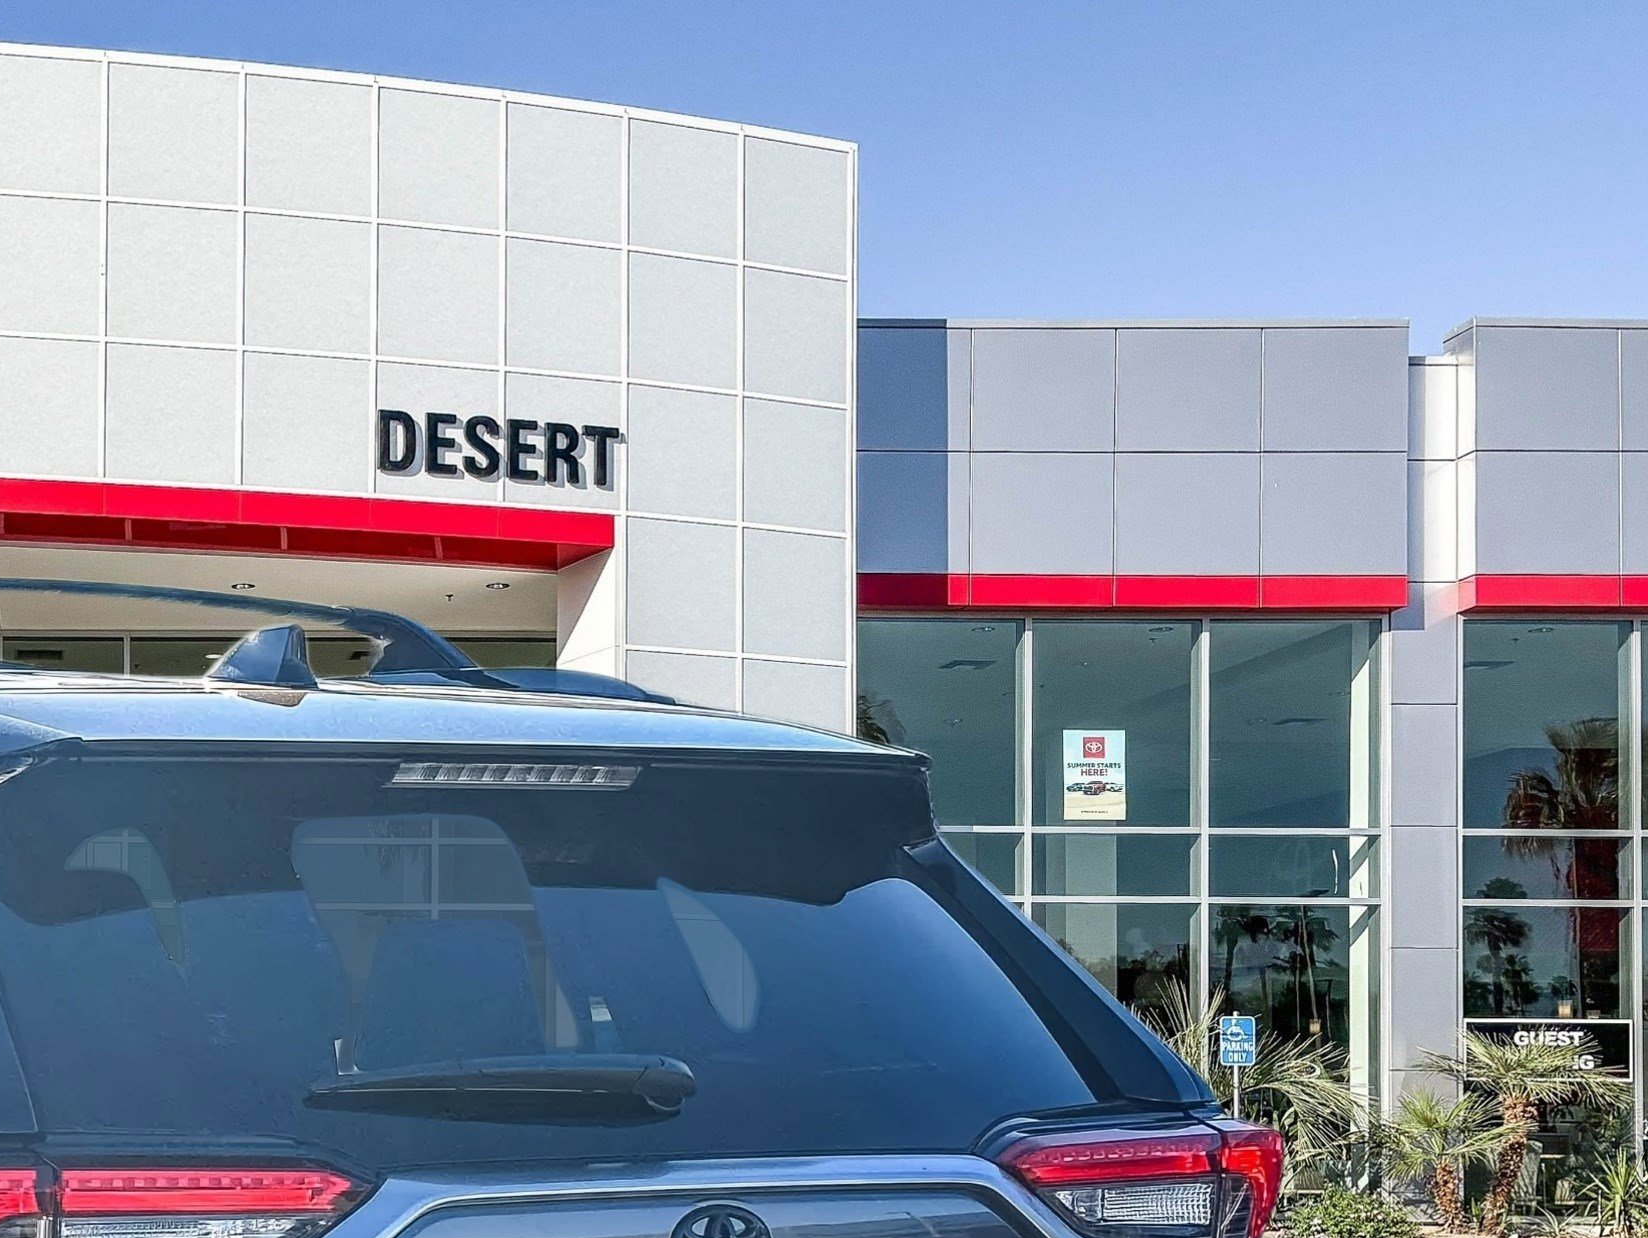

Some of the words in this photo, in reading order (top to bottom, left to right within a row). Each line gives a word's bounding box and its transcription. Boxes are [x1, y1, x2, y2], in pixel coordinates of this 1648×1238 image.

[377, 409, 619, 486] DESERT
[1080, 768, 1108, 776] HERE!
[1513, 1031, 1584, 1047] GUEST
[1222, 1041, 1253, 1052] PARKING
[1228, 1051, 1248, 1063] ONLY
